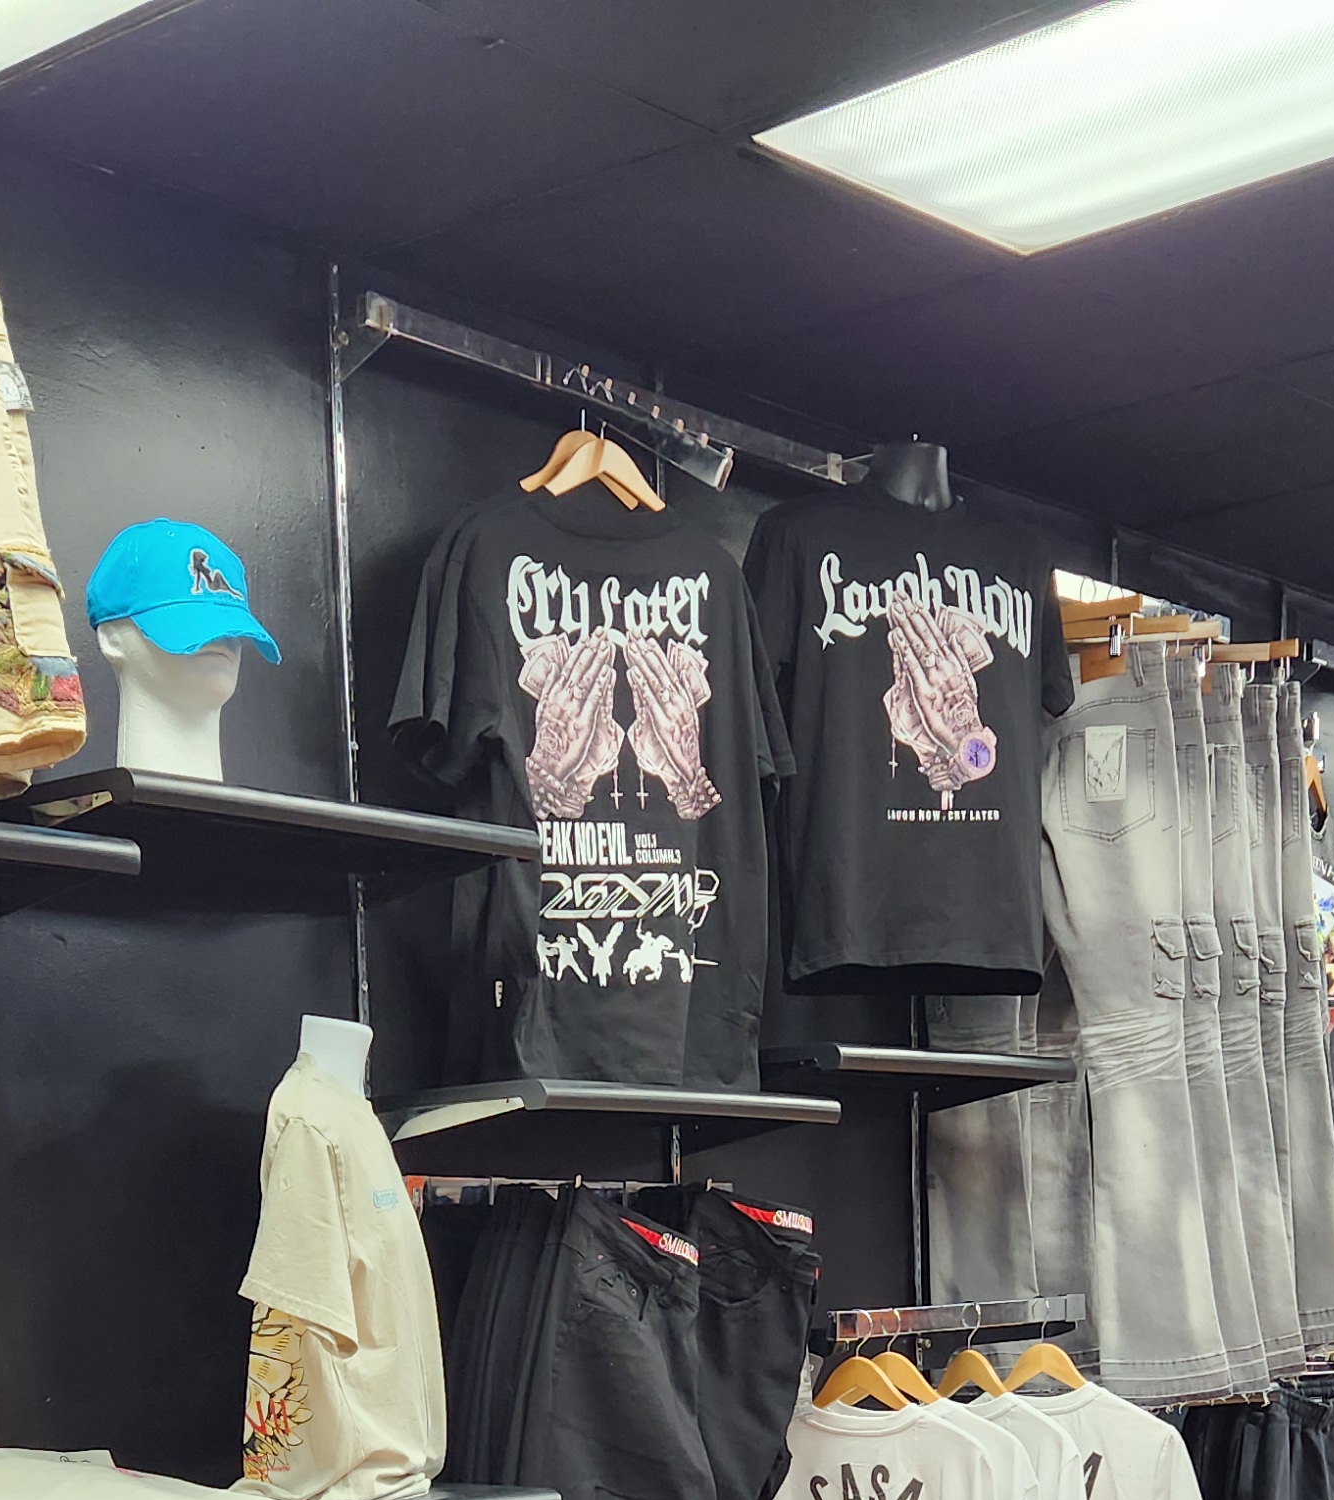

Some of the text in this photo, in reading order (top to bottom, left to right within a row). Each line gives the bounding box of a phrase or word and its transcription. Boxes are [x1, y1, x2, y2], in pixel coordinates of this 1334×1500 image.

[506, 555, 710, 651] Cry Later
[813, 552, 1033, 659] Laugh Now
[538, 821, 633, 865] EAK NO EVIL
